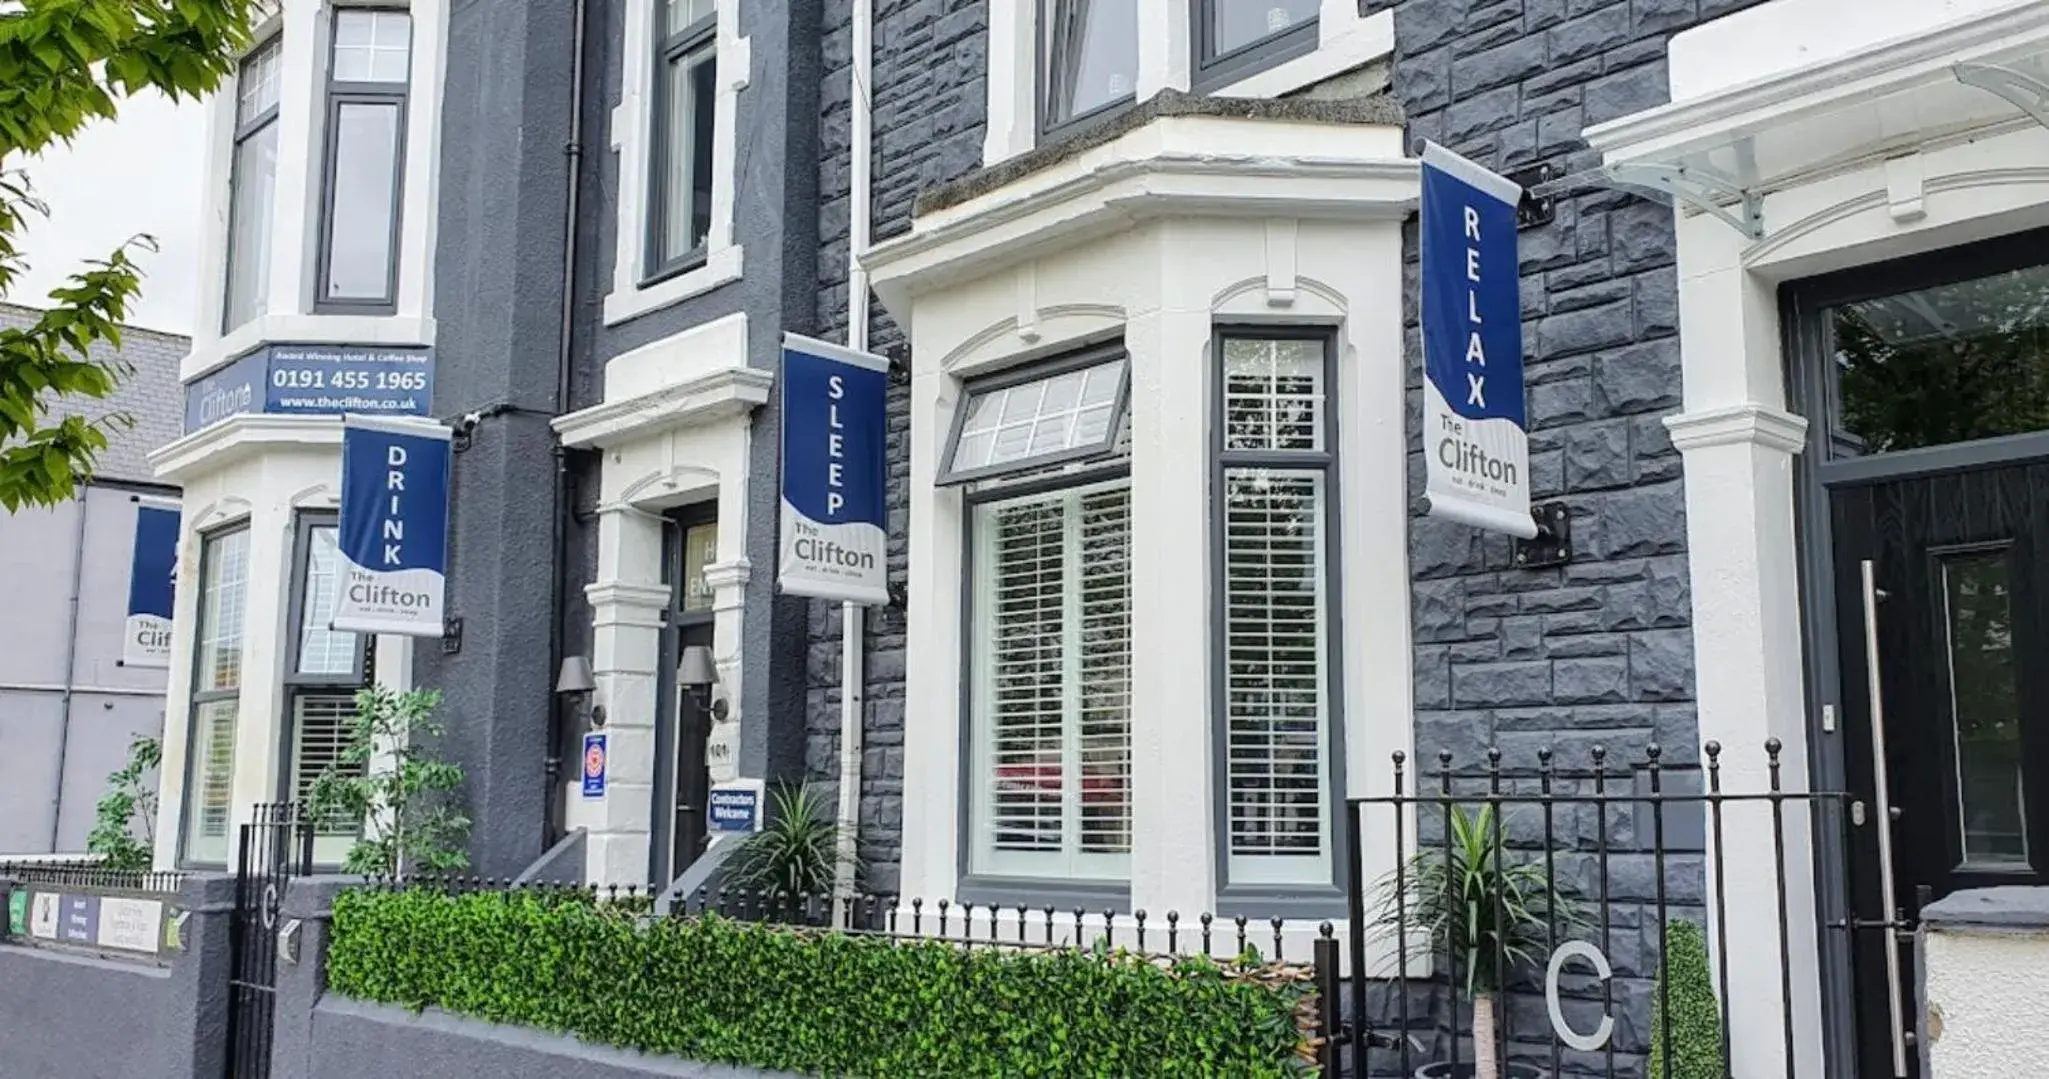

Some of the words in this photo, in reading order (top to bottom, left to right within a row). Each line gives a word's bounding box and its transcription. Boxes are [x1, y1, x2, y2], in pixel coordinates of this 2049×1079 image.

[1464, 205, 1486, 409] RELAX
[273, 369, 325, 388] 0191
[331, 370, 369, 389] 455
[376, 371, 427, 390] 1965
[199, 387, 244, 425] Clifton
[280, 396, 417, 410] www.theclifton.co.uk
[1440, 413, 1463, 436] The
[827, 375, 845, 516] SLEEP
[1439, 437, 1517, 486] Clifton
[383, 445, 407, 565] DRINK
[795, 521, 819, 537] The
[795, 539, 874, 569] Clifton
[352, 572, 374, 582] The
[349, 584, 430, 608] Clifton
[139, 619, 158, 630] The
[711, 793, 755, 806] Contractors
[715, 807, 750, 820] Welcome
[1546, 939, 1615, 1052] C
